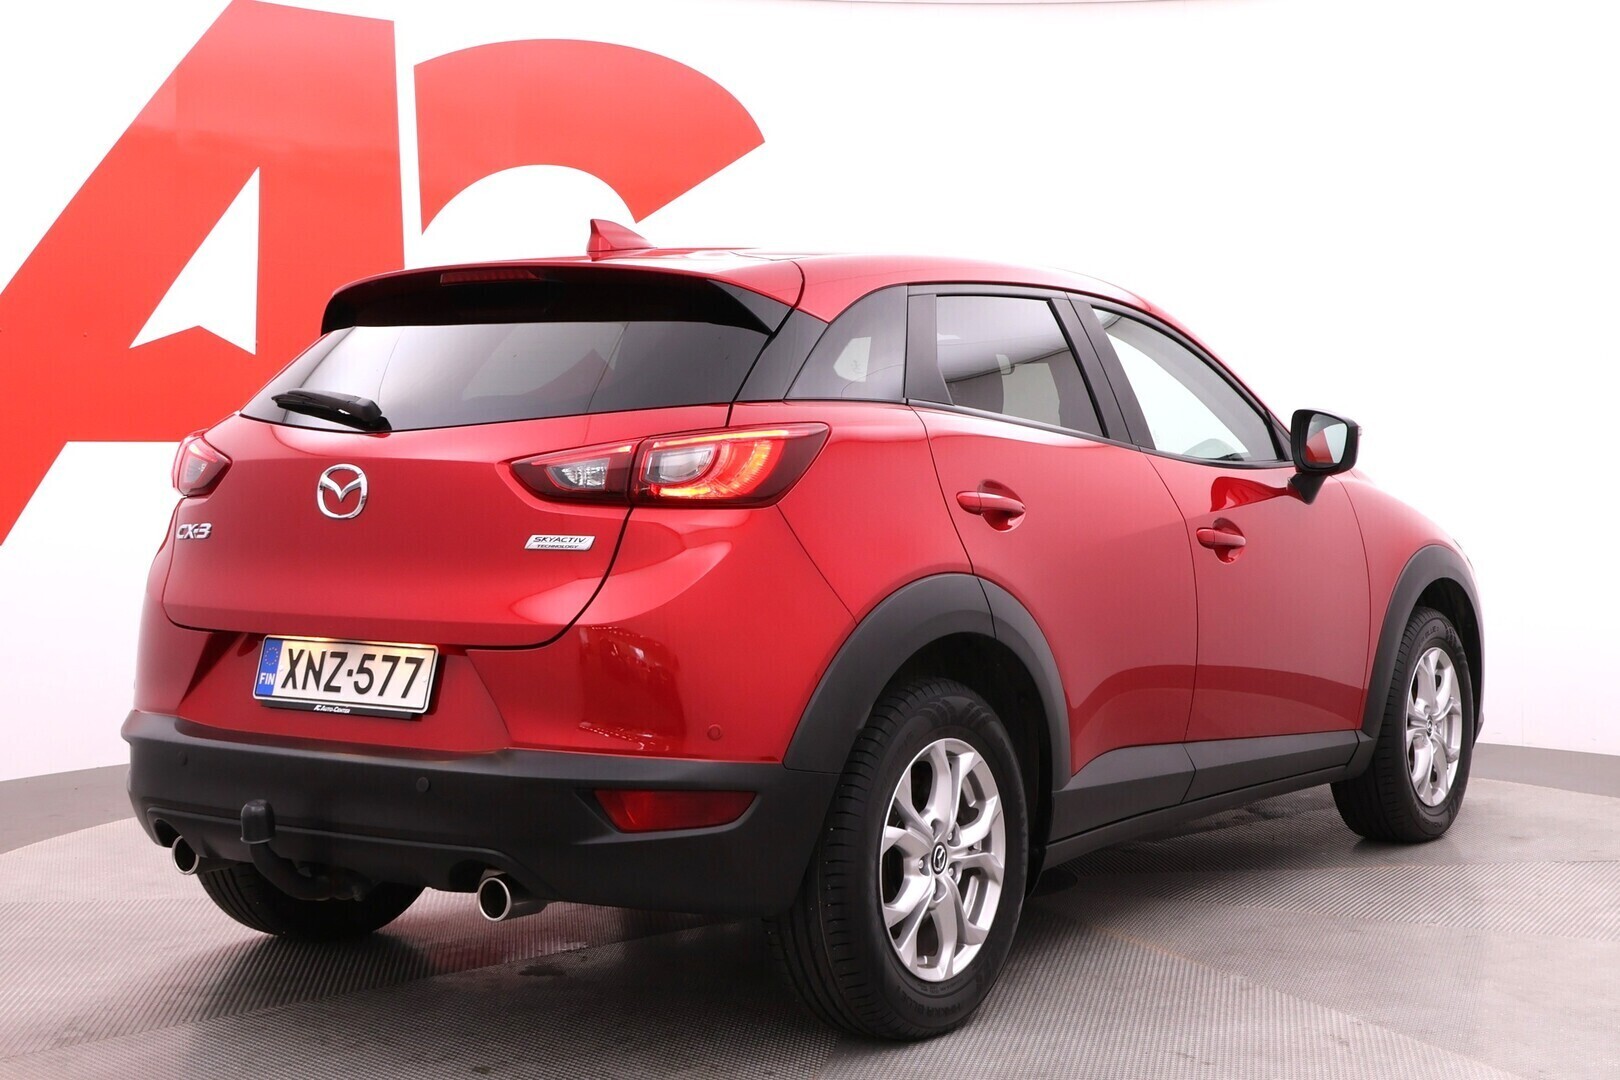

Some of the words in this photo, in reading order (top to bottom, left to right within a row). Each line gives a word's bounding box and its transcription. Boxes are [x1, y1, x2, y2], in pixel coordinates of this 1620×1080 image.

[176, 523, 212, 539] CX-3
[259, 672, 276, 685] FIN
[281, 648, 426, 699] XNZ-577
